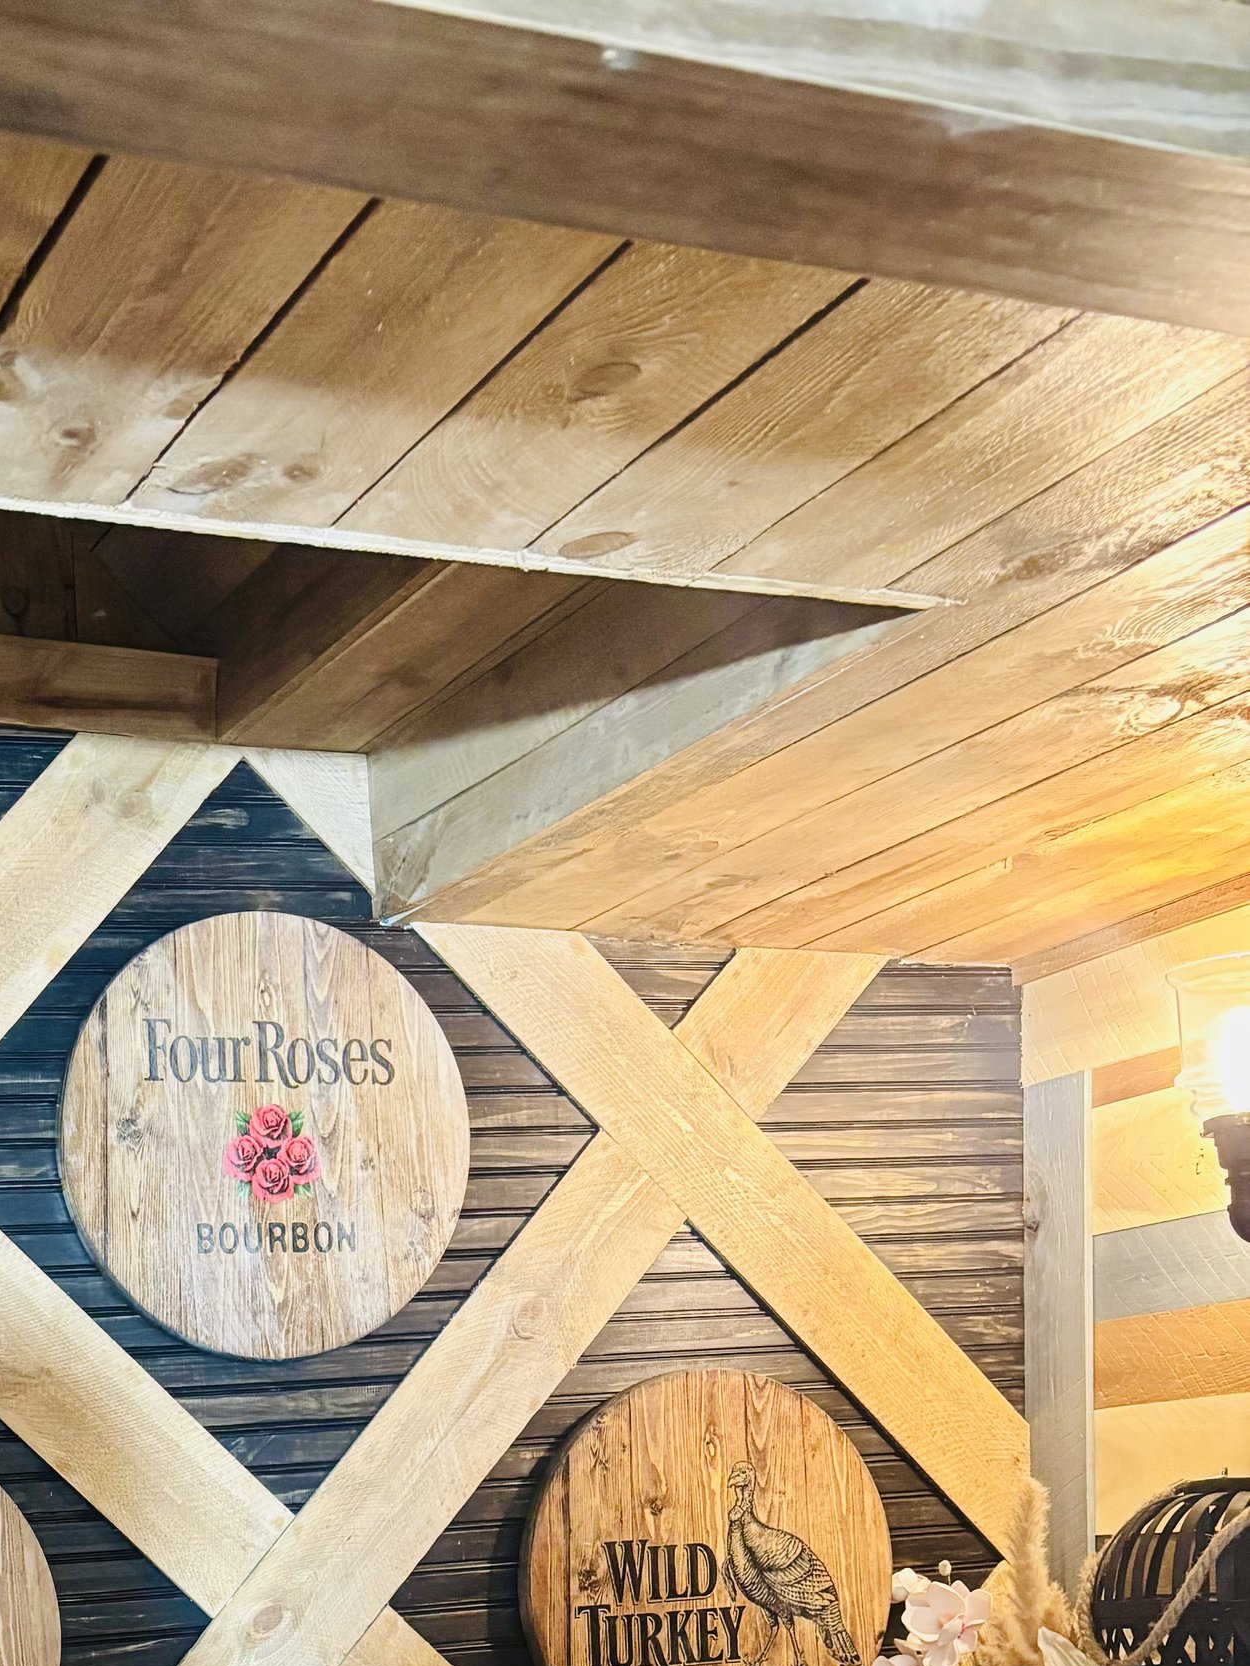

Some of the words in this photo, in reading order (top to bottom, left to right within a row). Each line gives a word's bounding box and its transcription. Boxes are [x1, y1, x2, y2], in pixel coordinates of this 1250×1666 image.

[143, 1017, 251, 1084] Four
[252, 1020, 396, 1090] Roses
[196, 1221, 356, 1255] BOURBON
[602, 1539, 717, 1605] WILD
